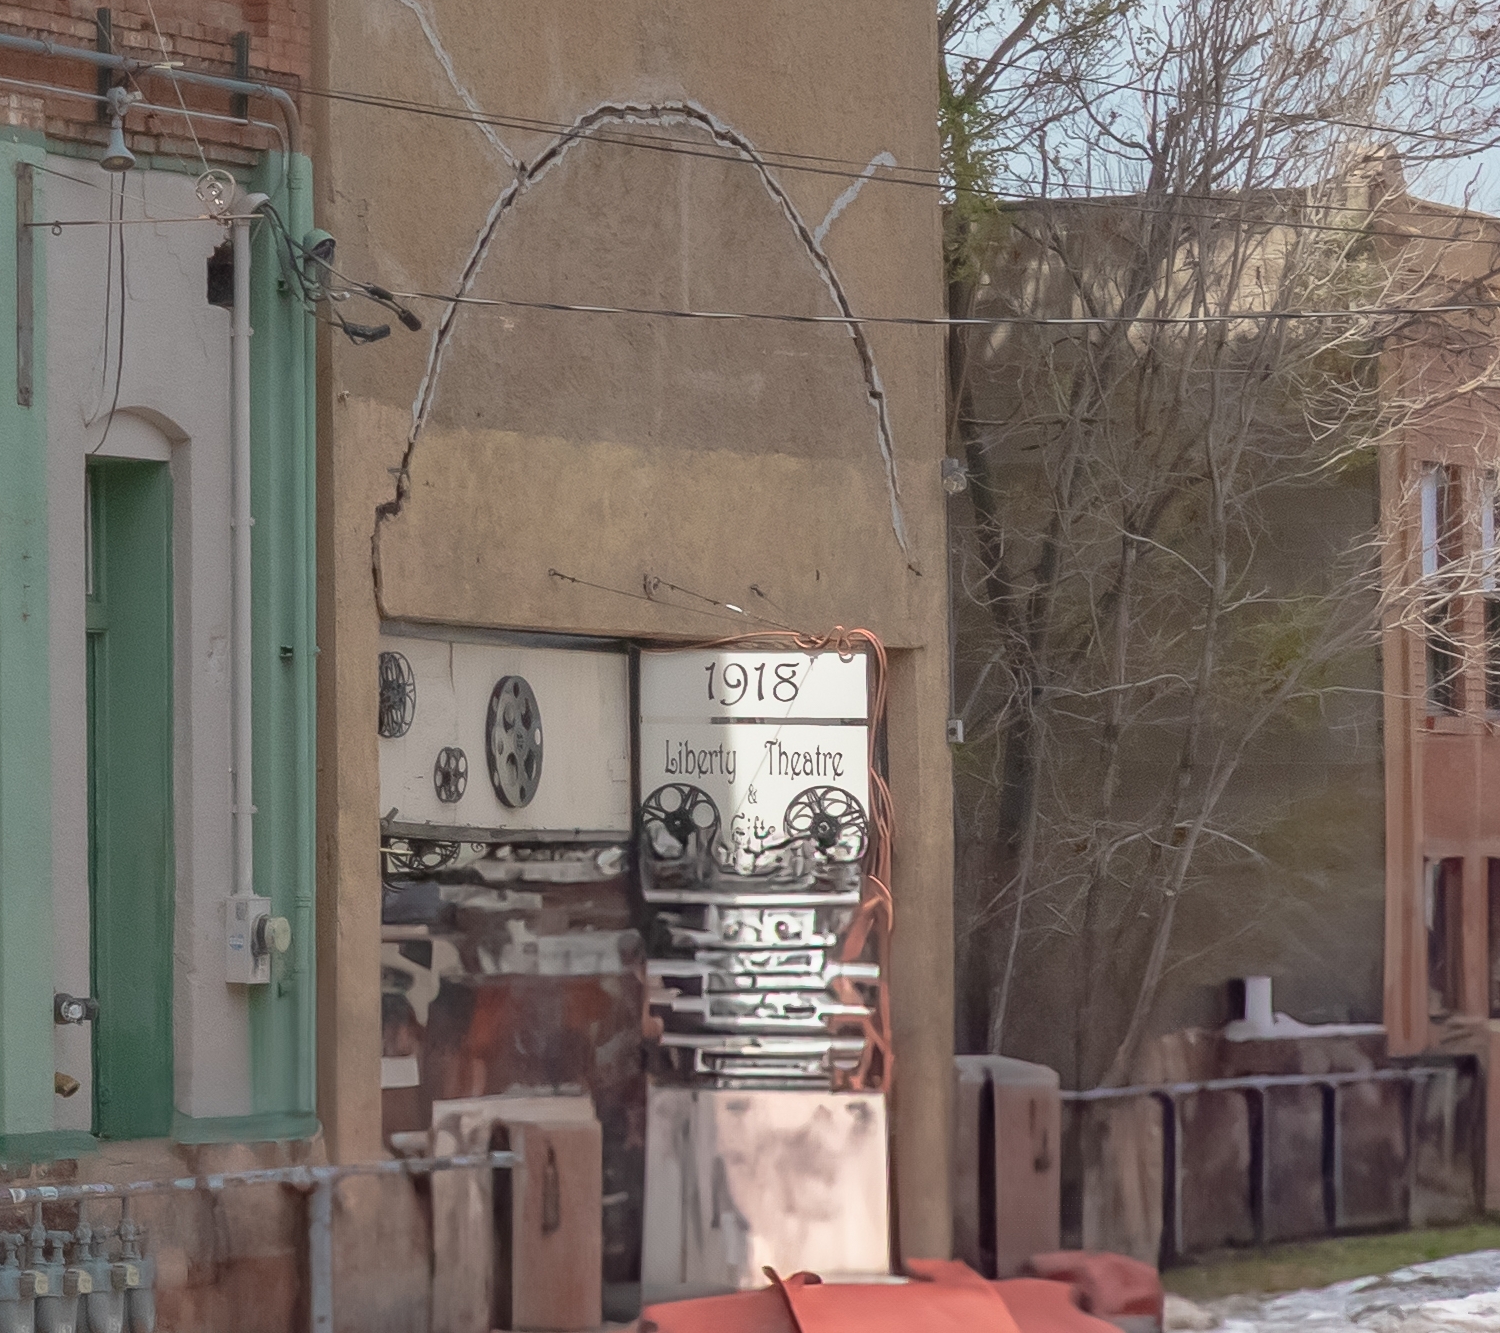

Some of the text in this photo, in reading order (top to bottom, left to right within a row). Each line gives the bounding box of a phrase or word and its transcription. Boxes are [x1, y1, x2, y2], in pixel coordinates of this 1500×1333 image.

[705, 661, 800, 706] 1918
[664, 738, 845, 784] Liberty Theatre
[747, 784, 758, 804] &
